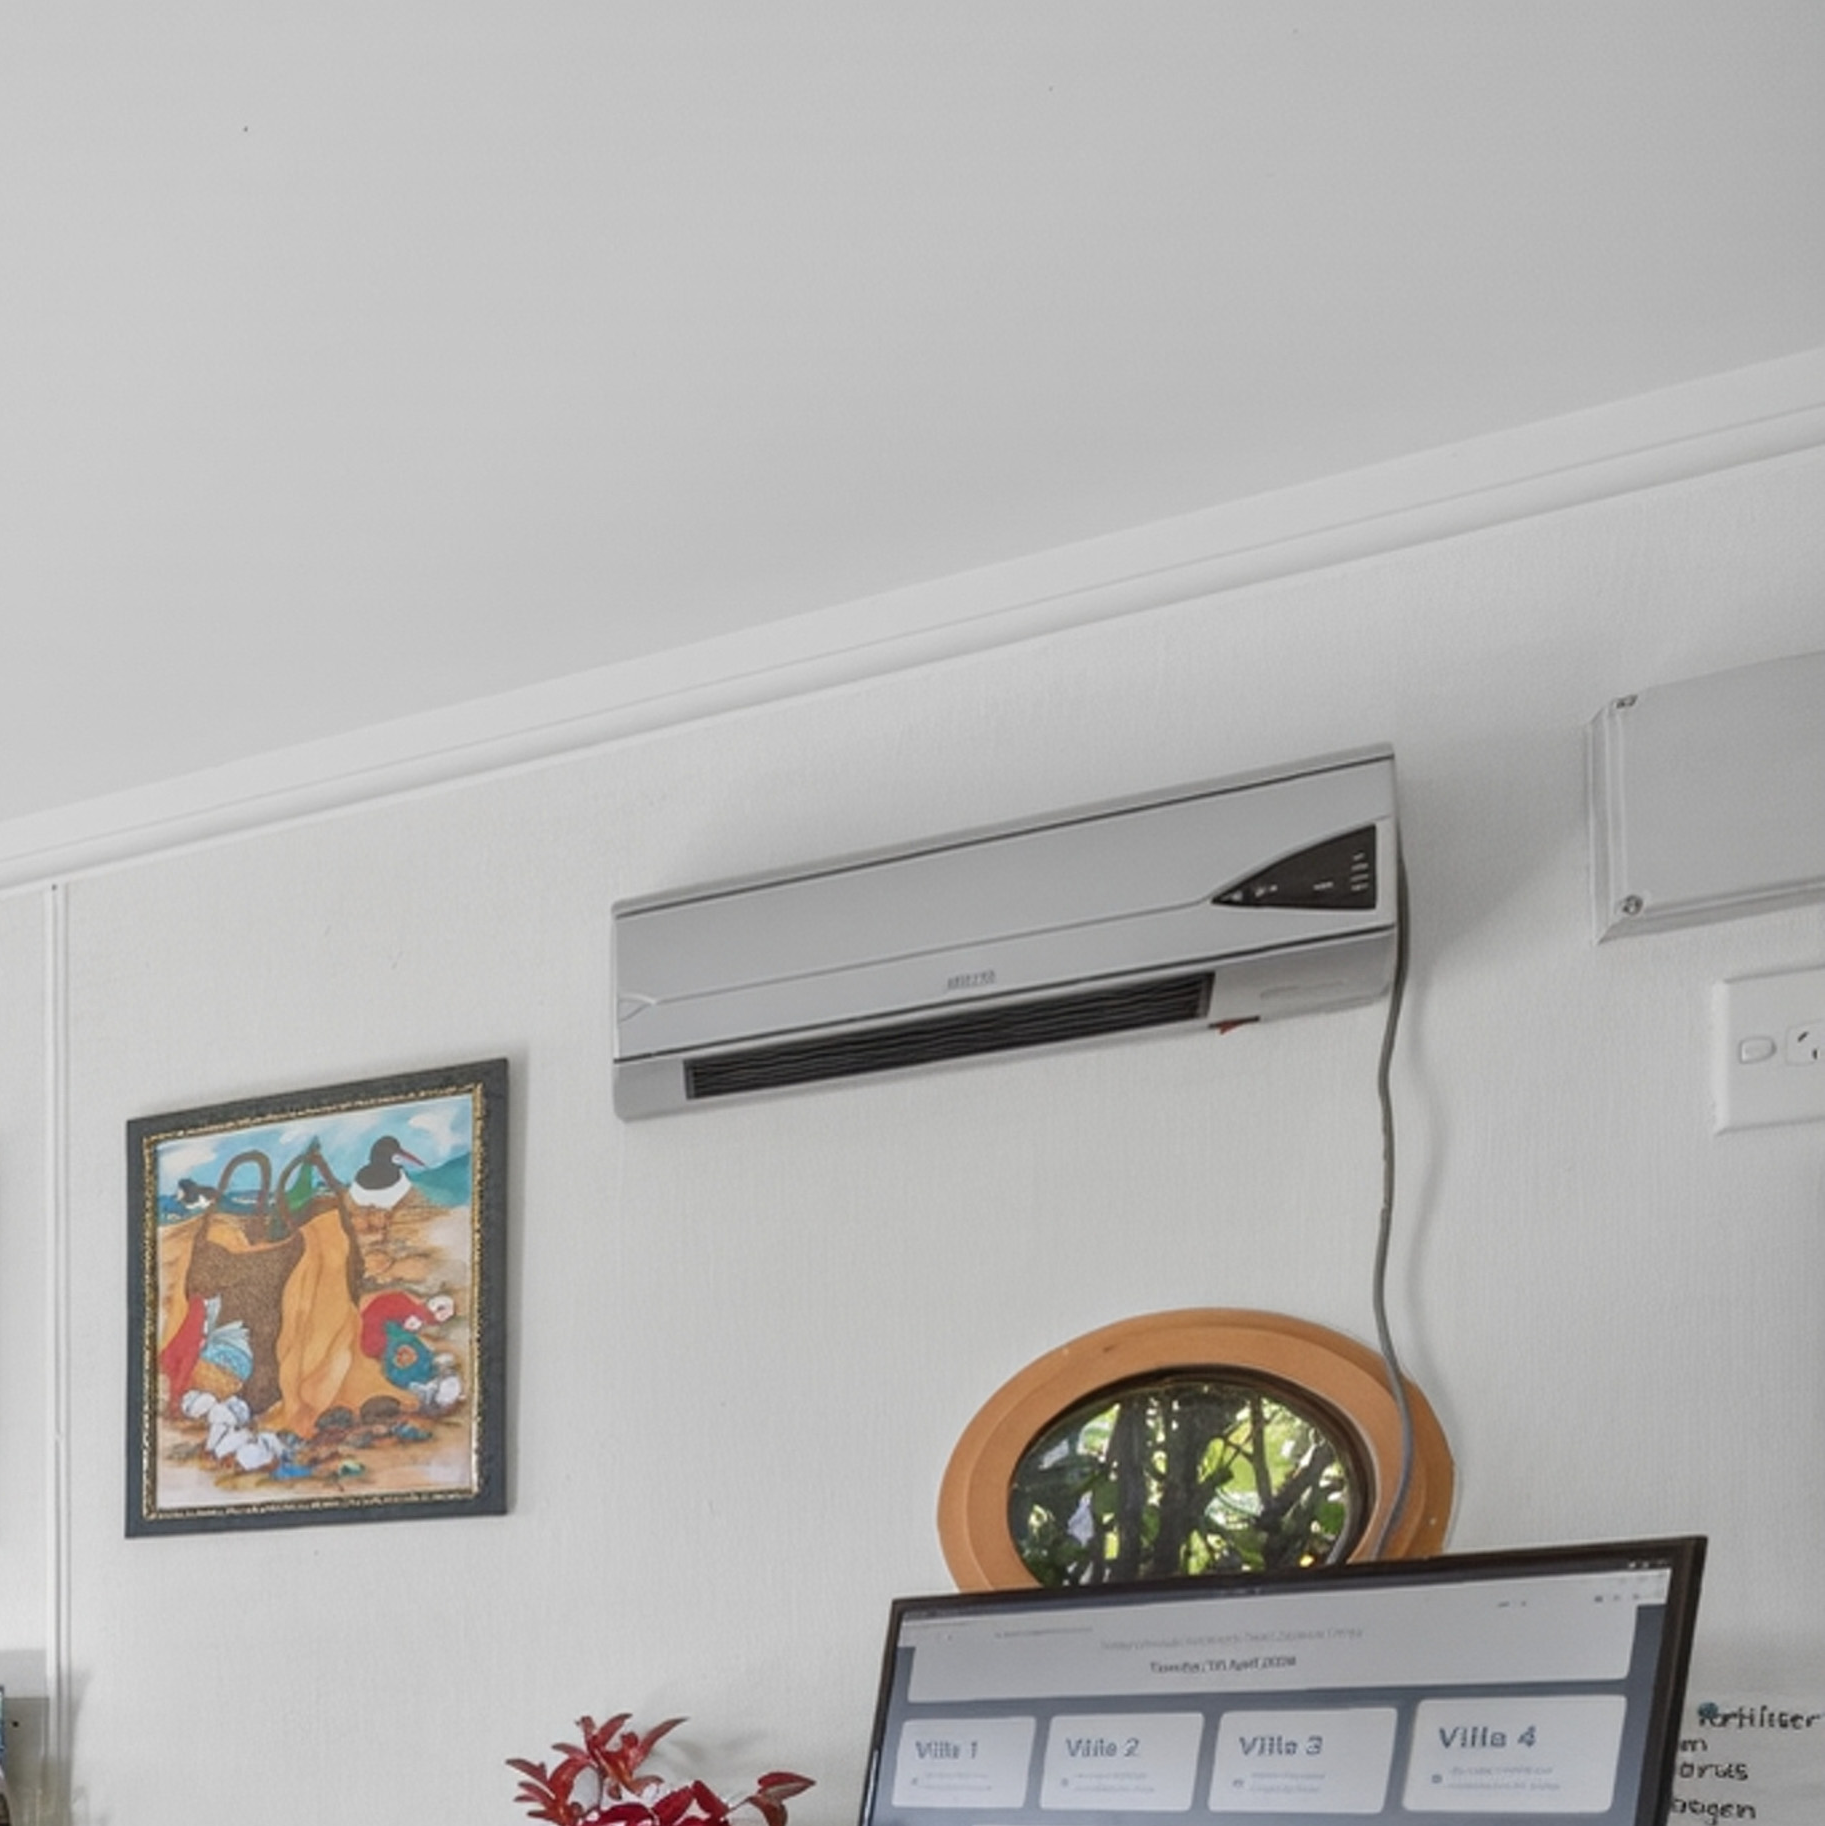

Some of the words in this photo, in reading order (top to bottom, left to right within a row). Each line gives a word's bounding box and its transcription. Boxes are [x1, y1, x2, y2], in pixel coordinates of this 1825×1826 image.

[1239, 1735, 1298, 1756] Villa
[1305, 1735, 1324, 1756] 3
[1438, 1726, 1508, 1749] Villa
[1516, 1724, 1538, 1748] 4
[915, 1740, 960, 1760] Villa
[969, 1740, 979, 1760] 1
[1065, 1738, 1117, 1758] Villa
[1123, 1737, 1141, 1757] 2
[1679, 1762, 1749, 1782] orus
